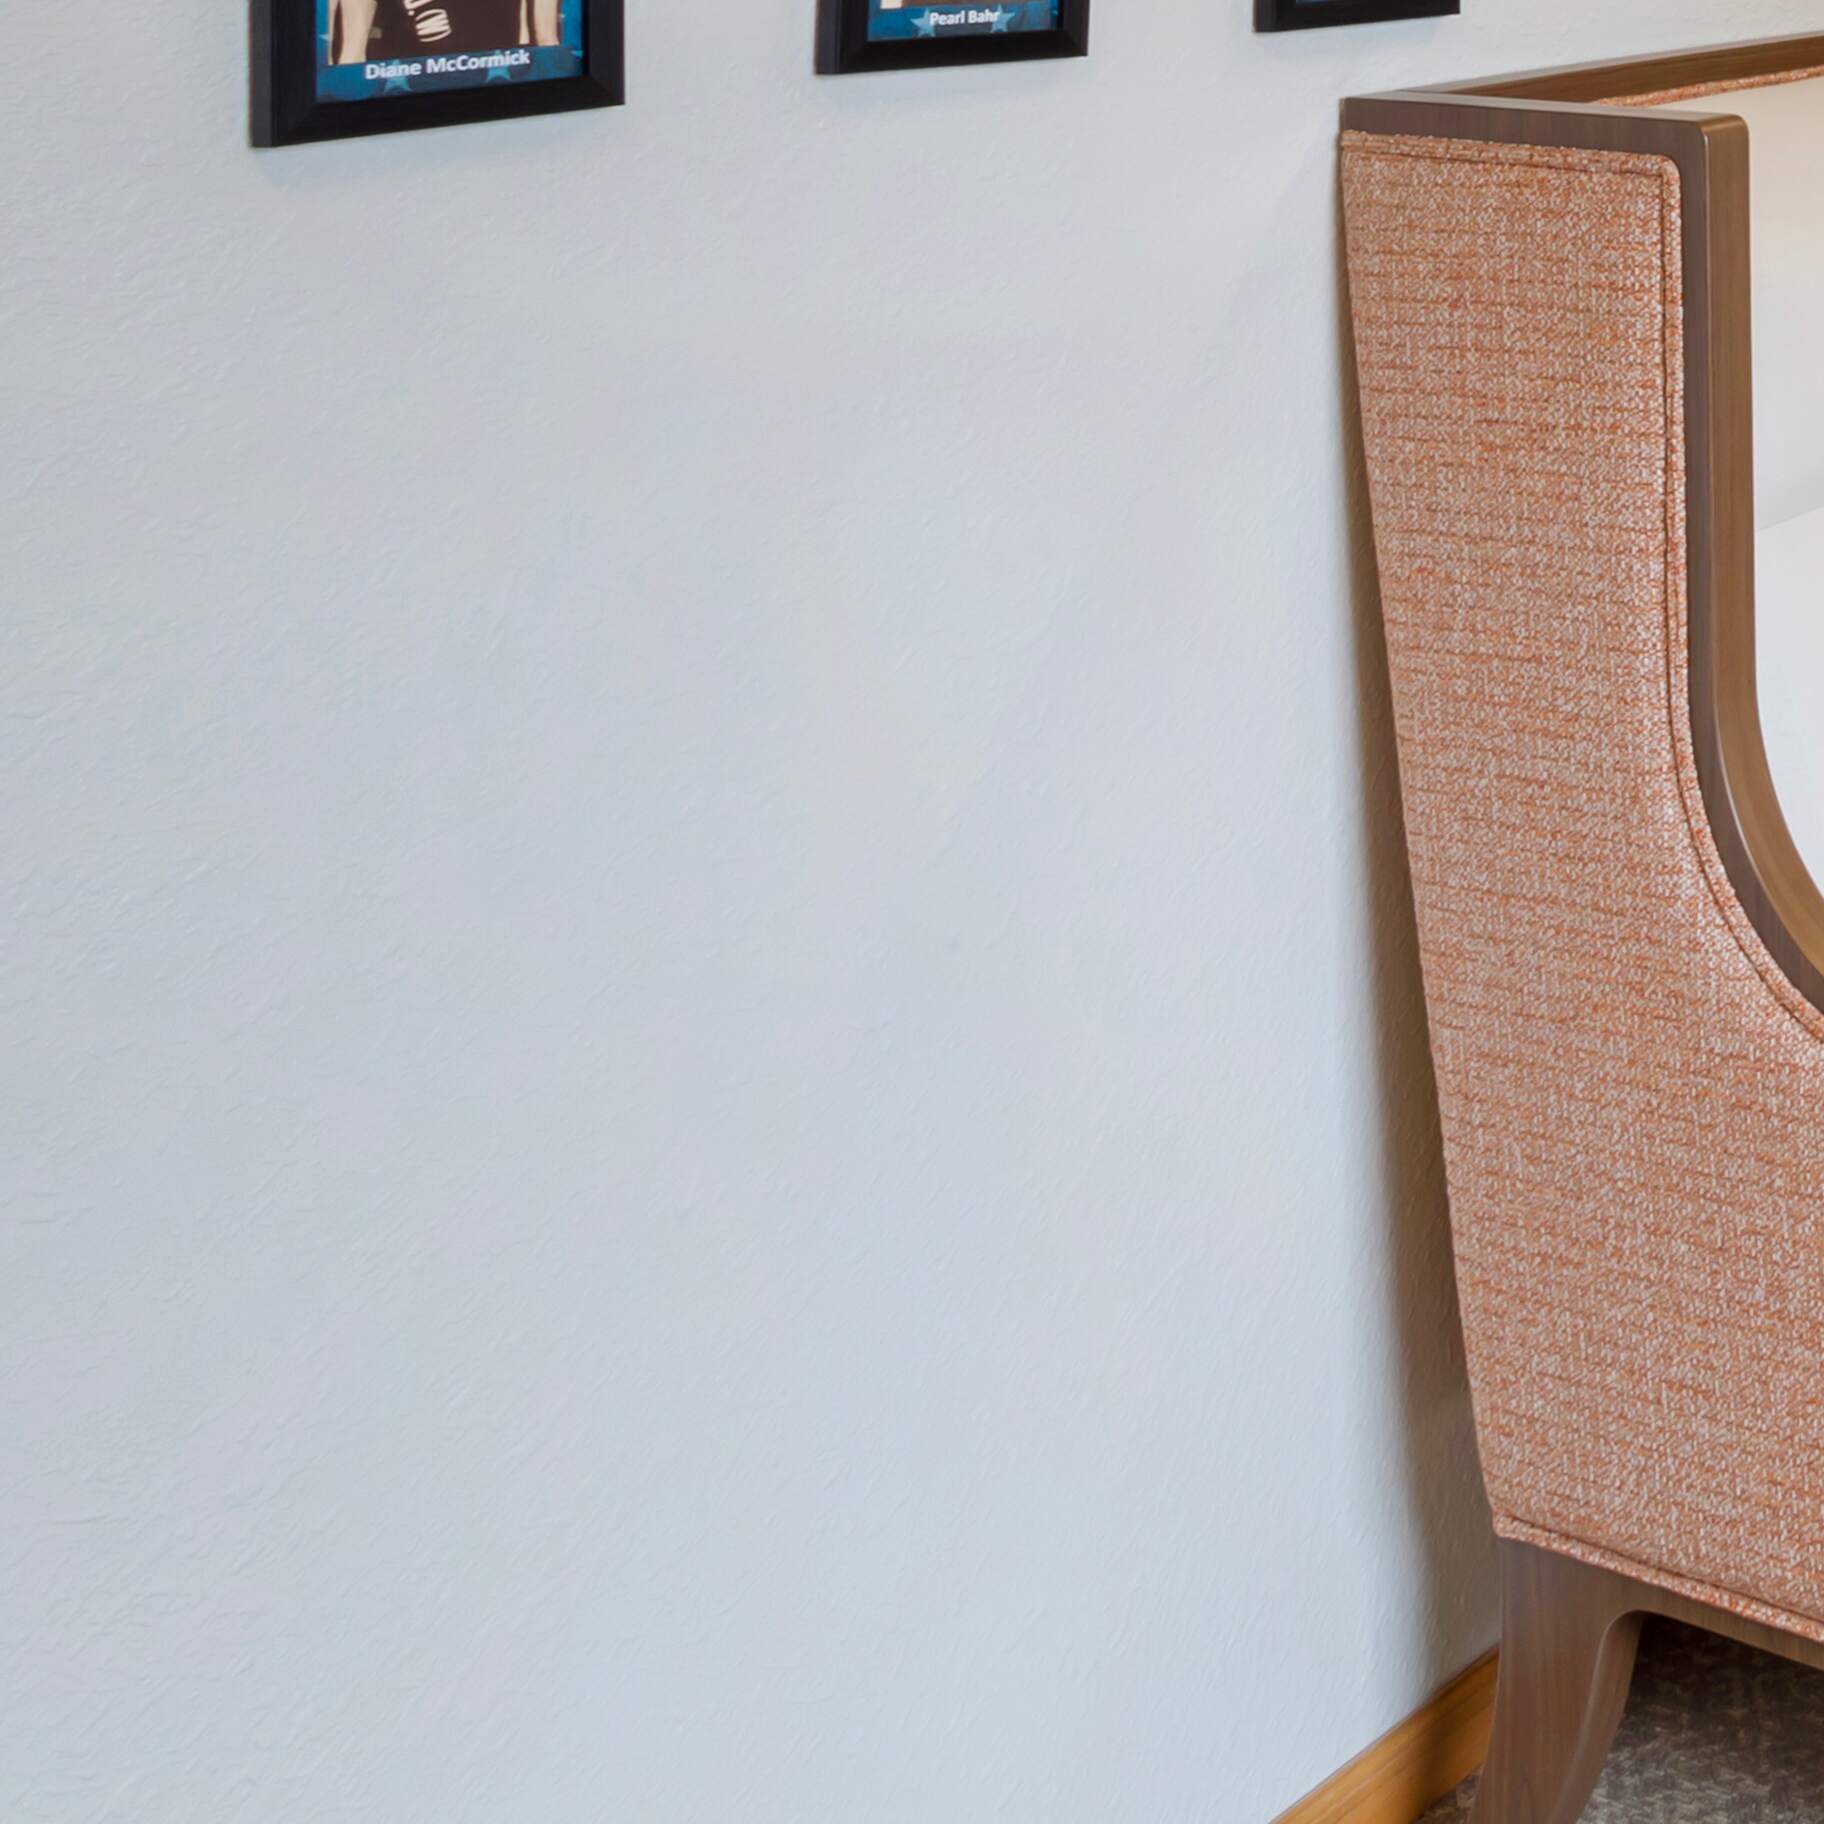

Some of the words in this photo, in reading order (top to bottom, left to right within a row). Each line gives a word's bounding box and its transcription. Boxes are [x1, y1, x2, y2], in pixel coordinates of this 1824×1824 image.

[416, 9, 452, 42] (W)
[930, 10, 965, 25] Pearl
[968, 9, 998, 23] Bahr
[365, 62, 421, 79] Diane
[427, 49, 530, 74] McCormick
